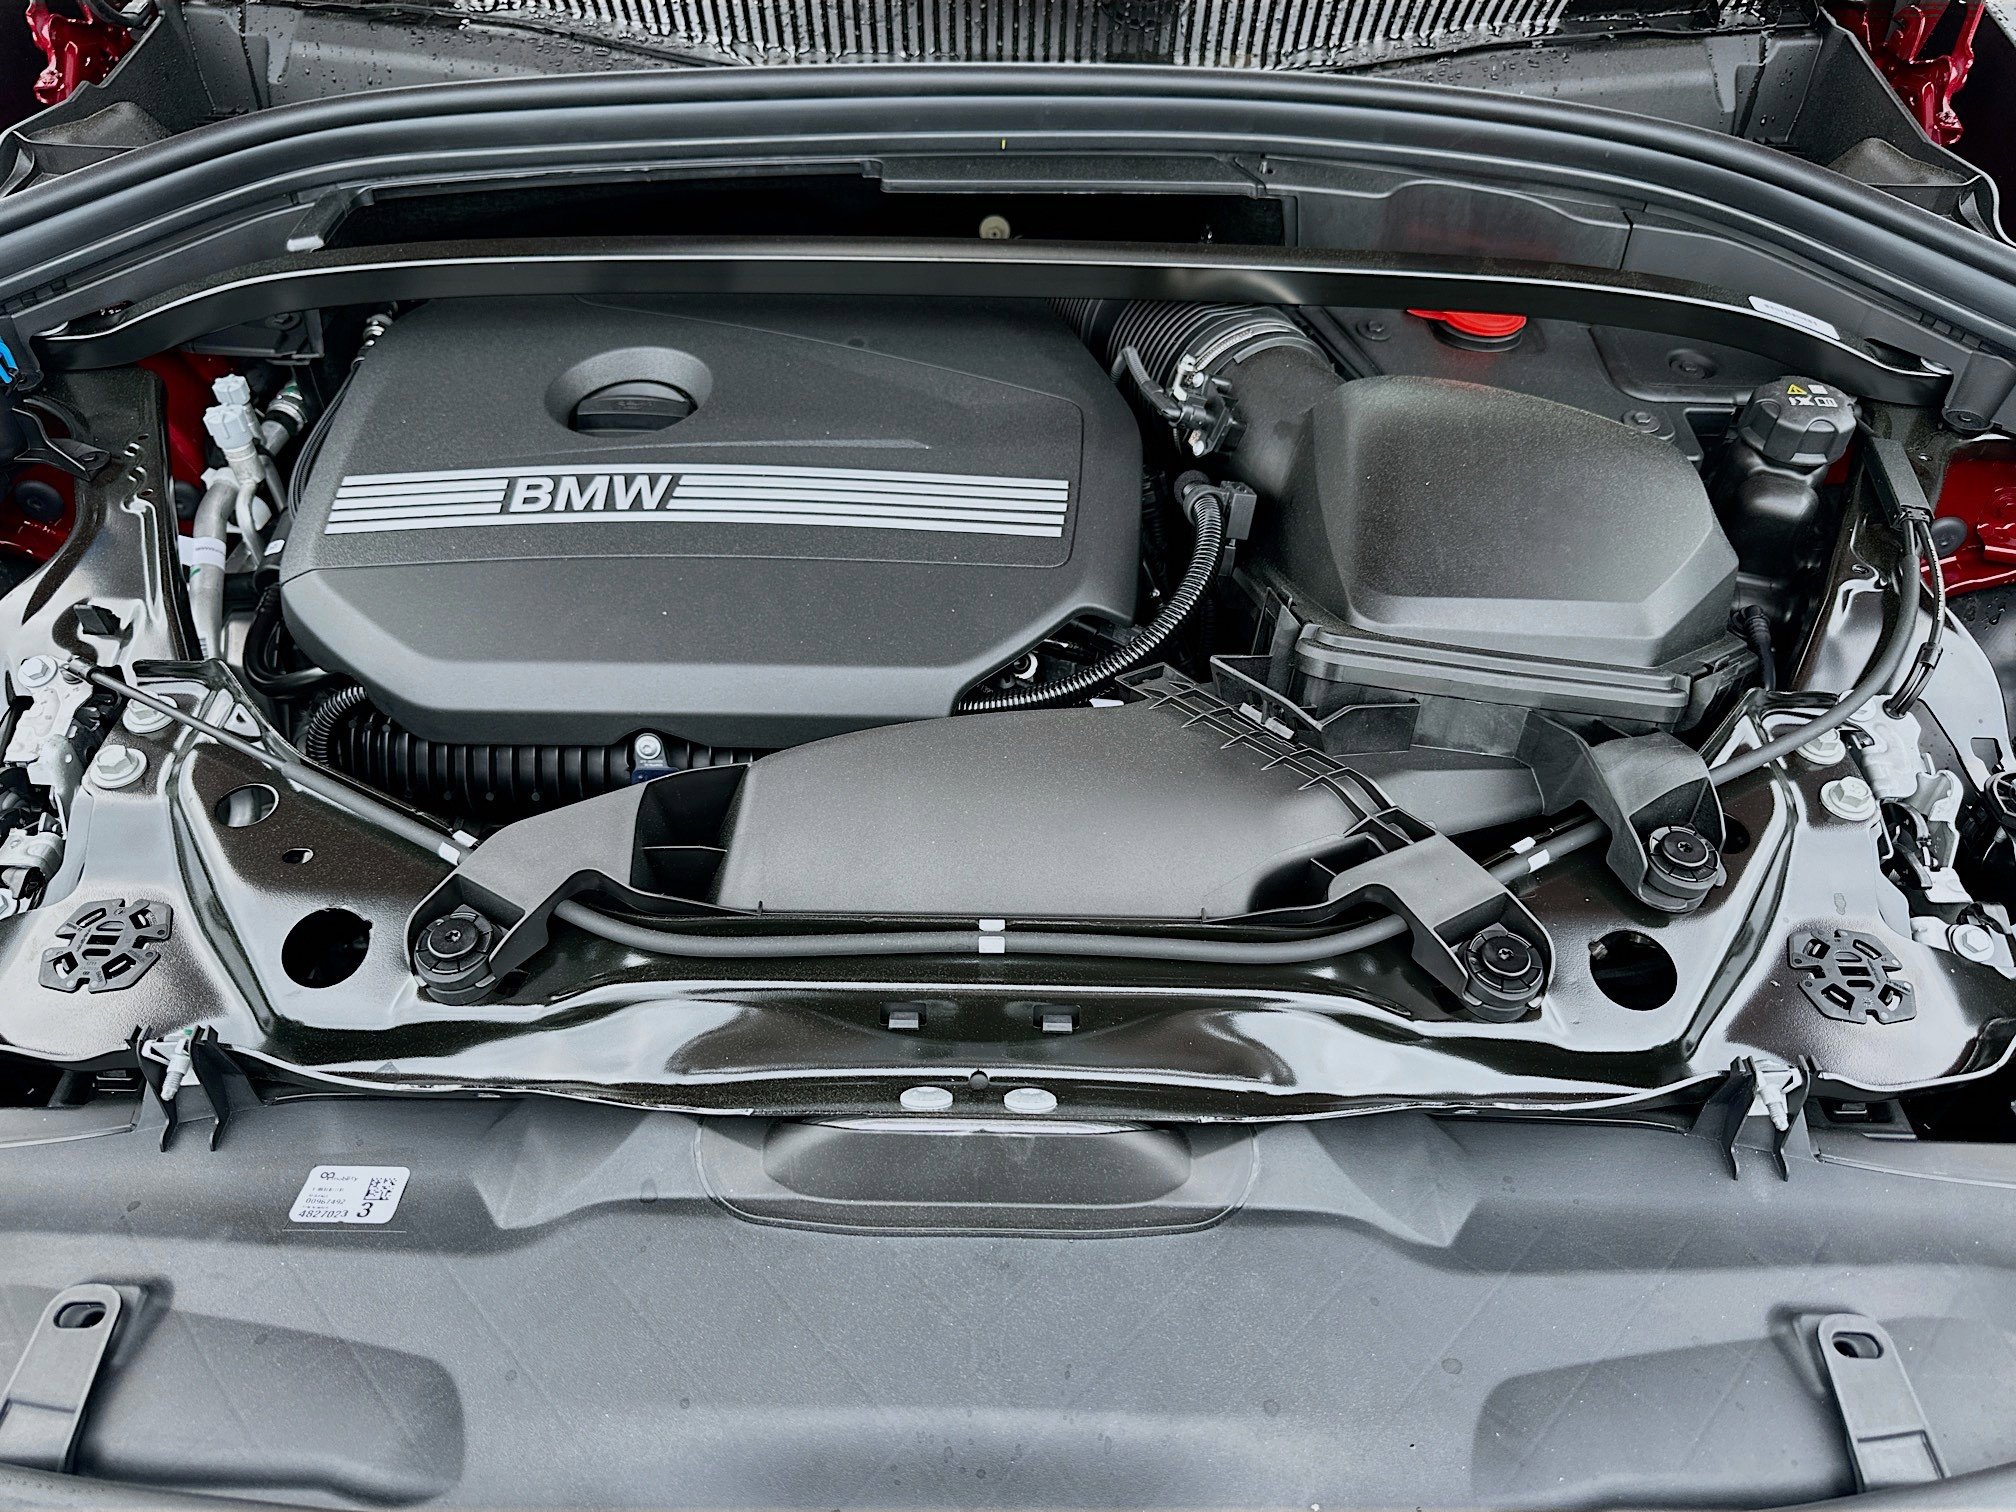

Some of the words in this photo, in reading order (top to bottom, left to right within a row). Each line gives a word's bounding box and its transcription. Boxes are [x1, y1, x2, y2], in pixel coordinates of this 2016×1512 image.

[509, 475, 673, 513] BMW
[299, 1209, 348, 1218] 4827023
[356, 1201, 374, 1218] 3
